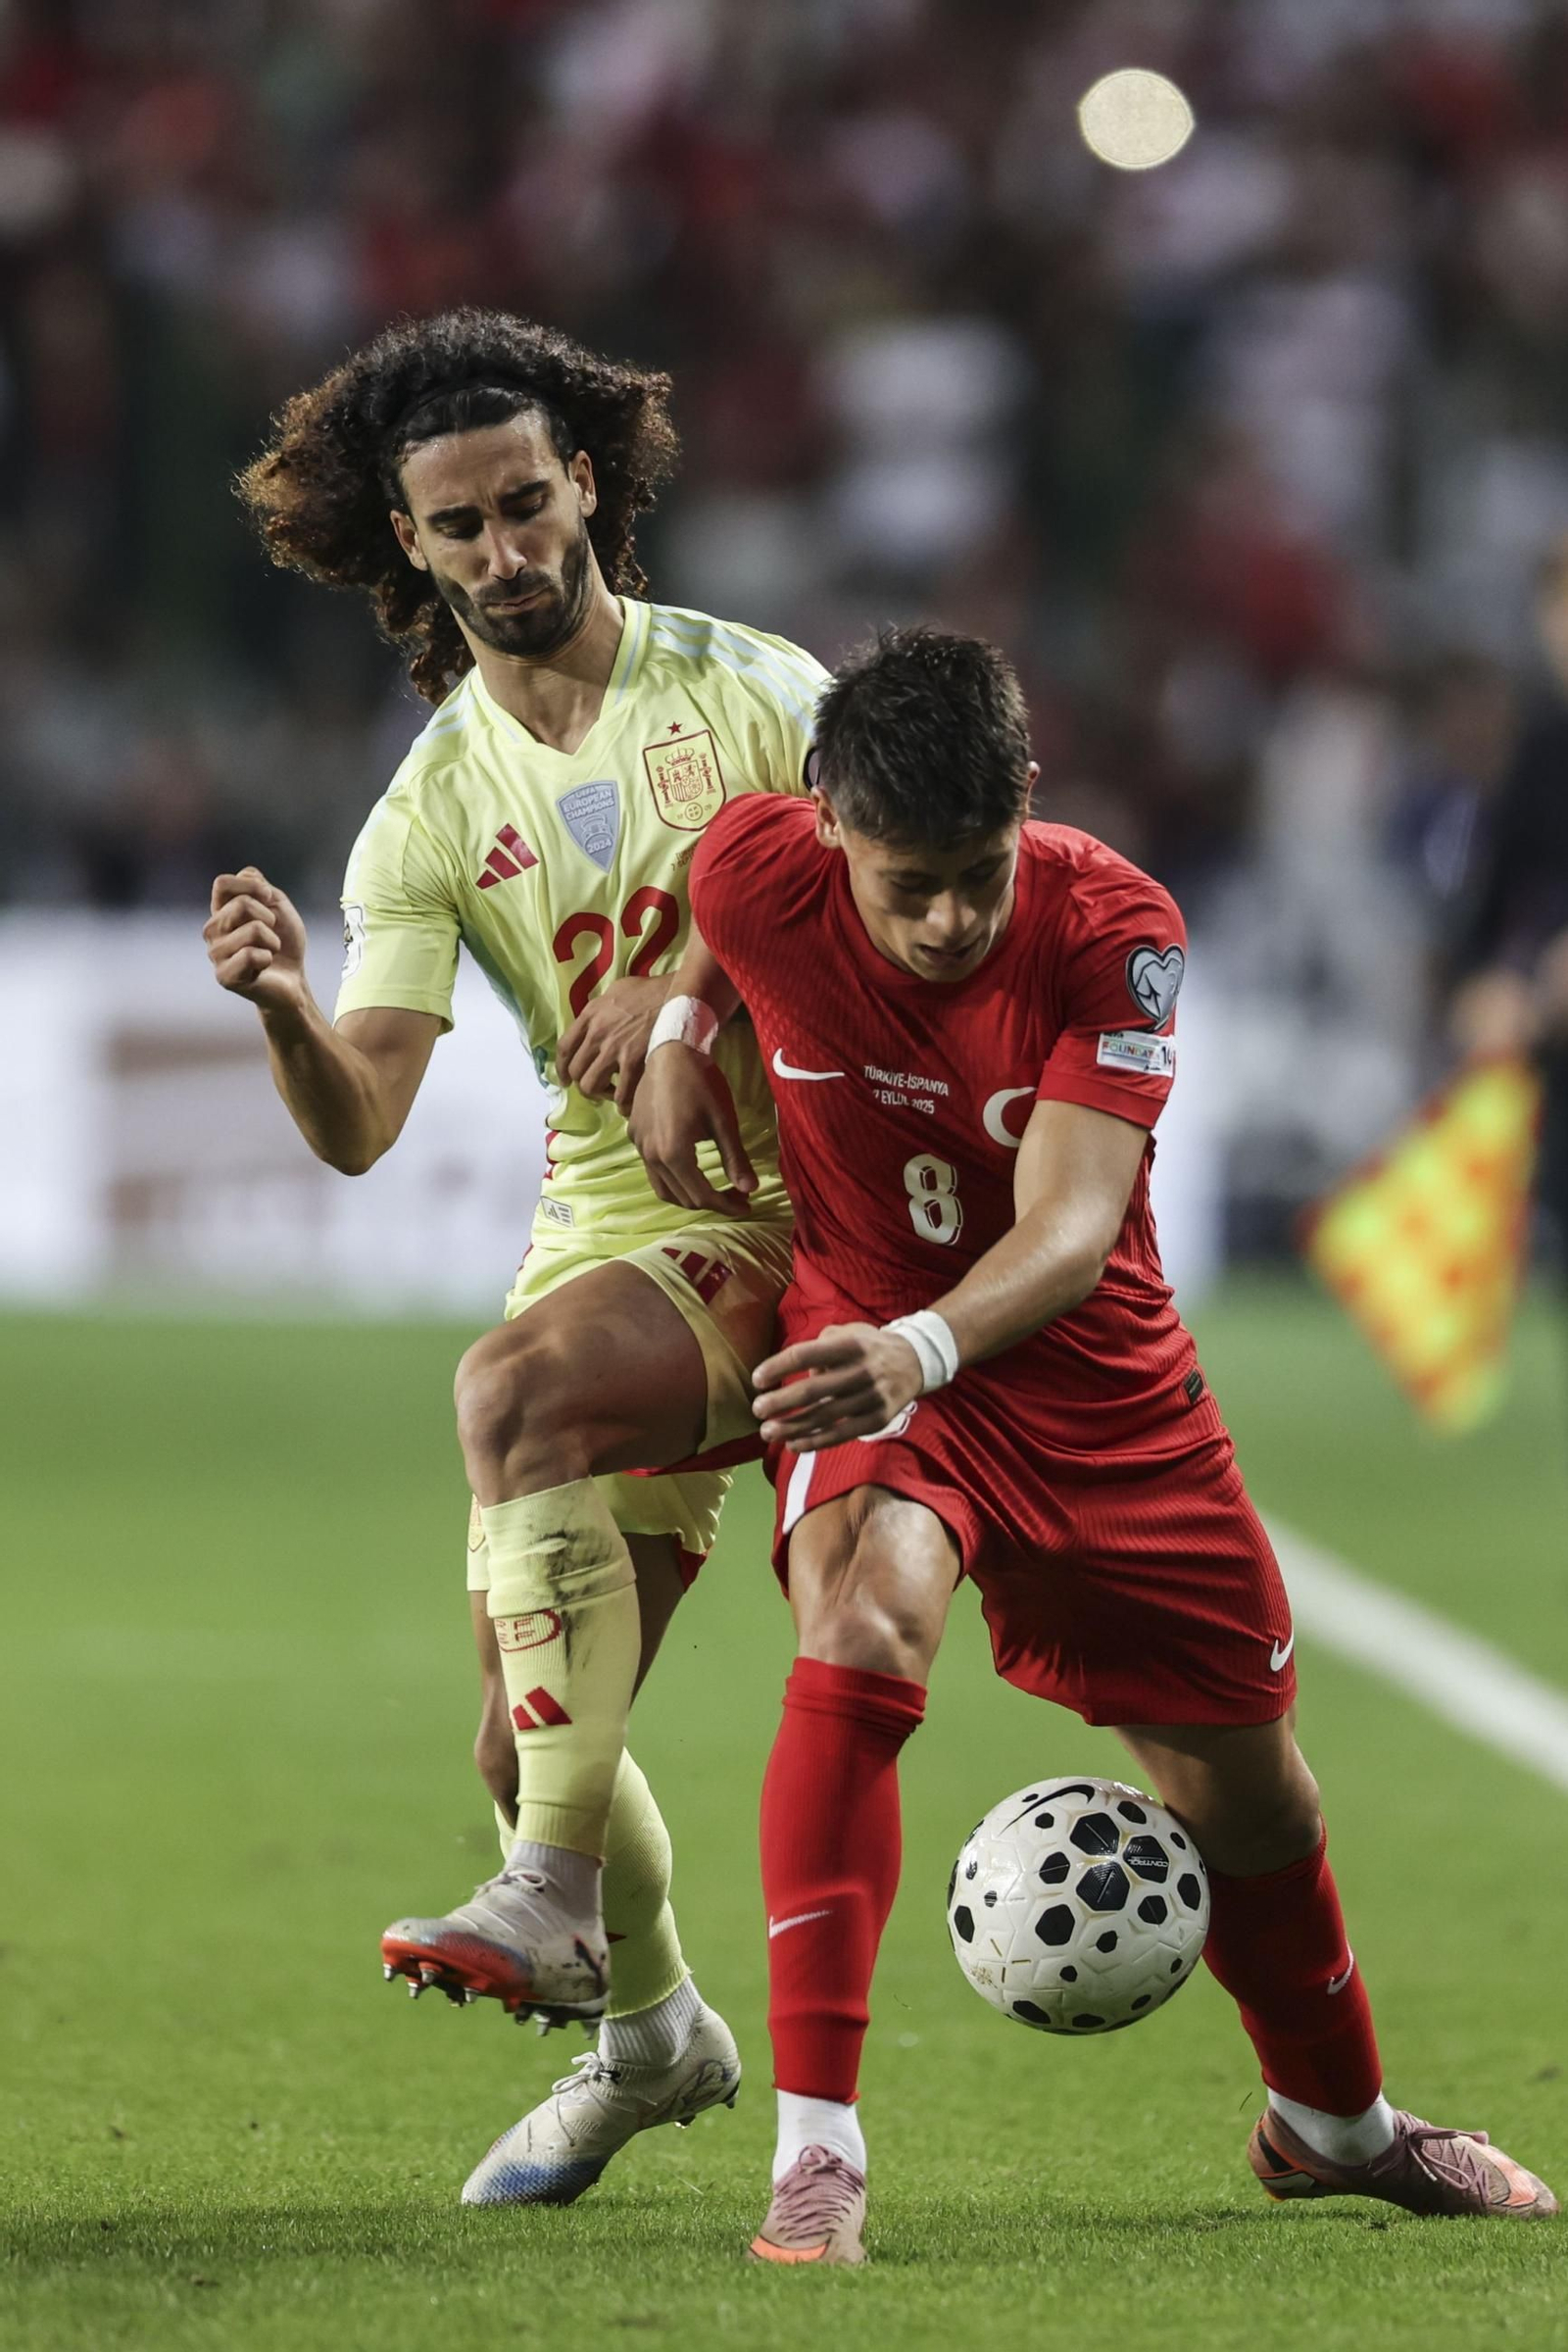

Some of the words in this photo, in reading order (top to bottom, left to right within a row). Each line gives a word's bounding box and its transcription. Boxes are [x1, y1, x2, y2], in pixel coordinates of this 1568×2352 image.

[563, 789, 613, 813] EUROPEAN
[565, 797, 615, 820] CHAMPIONS
[587, 839, 612, 854] 2024
[553, 886, 680, 1020] 22
[1102, 1041, 1154, 1057] FOUNDAT
[904, 1152, 963, 1245] 8
